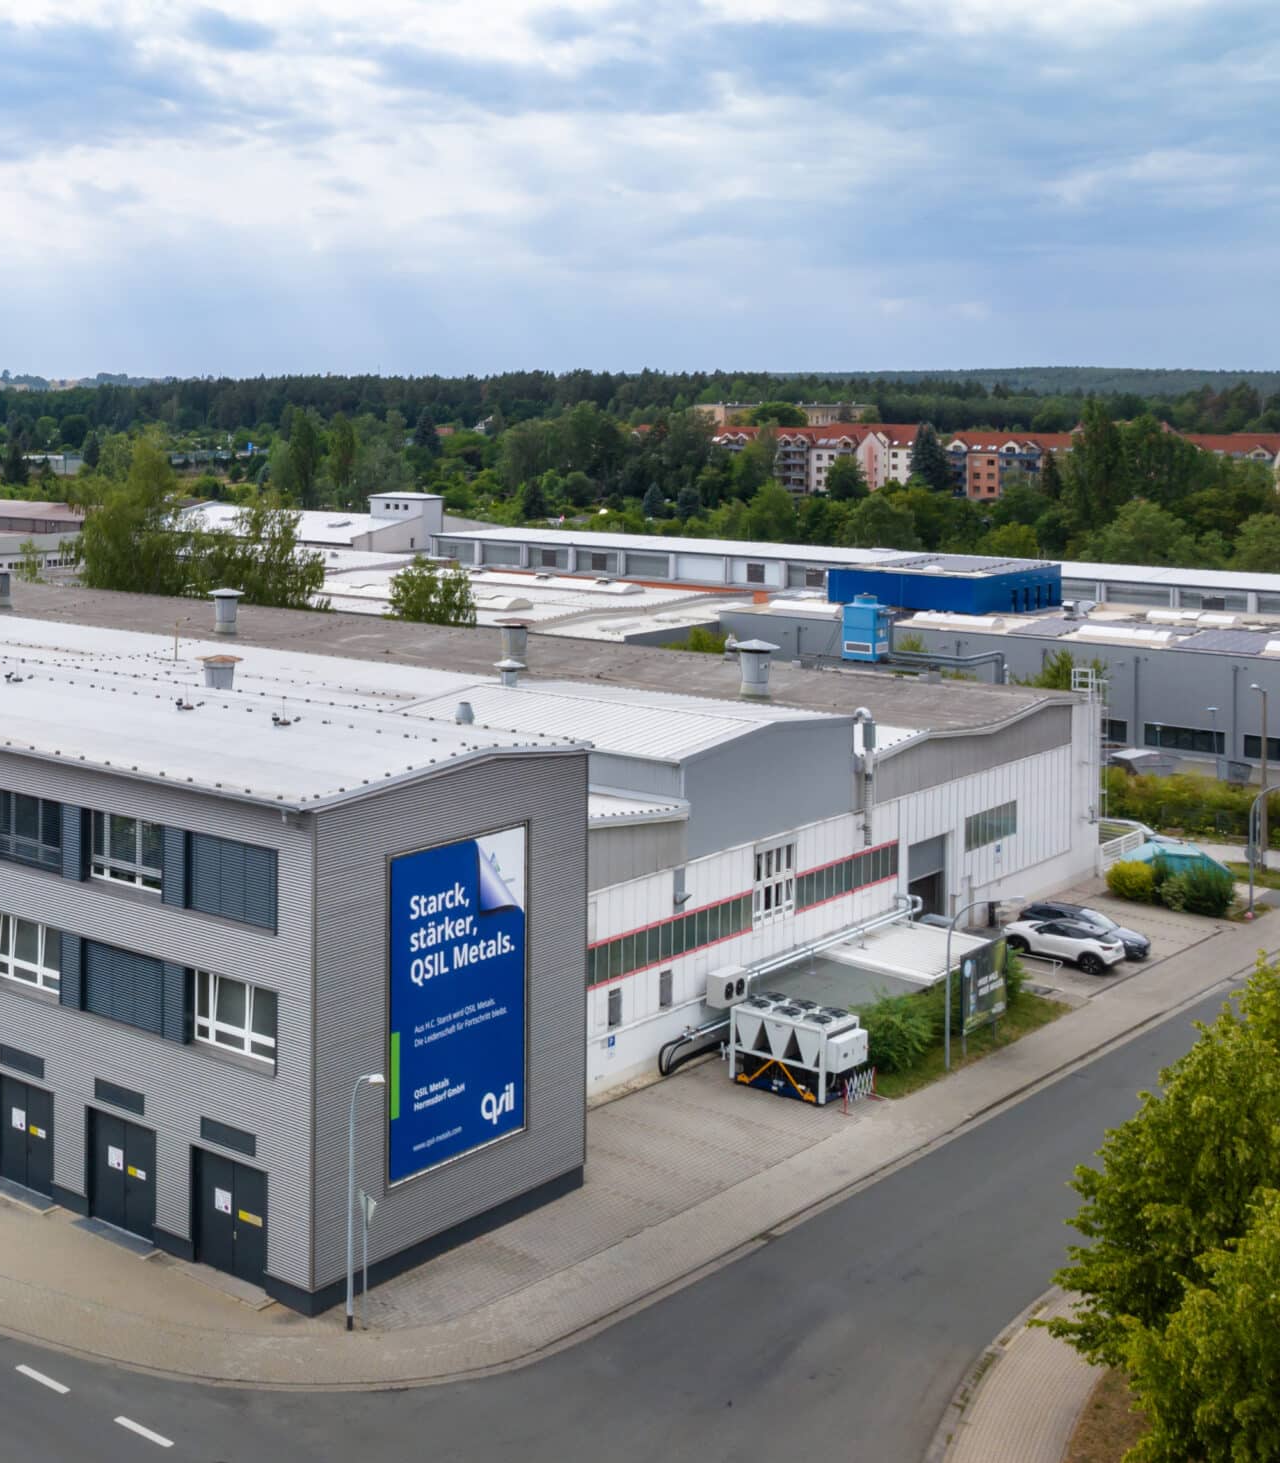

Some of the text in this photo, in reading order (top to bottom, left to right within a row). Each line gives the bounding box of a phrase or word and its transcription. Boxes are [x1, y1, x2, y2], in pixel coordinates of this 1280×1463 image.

[410, 882, 469, 920] Starck,
[410, 915, 478, 952] stärker,
[410, 931, 515, 986] QSIL Metals.
[413, 1078, 450, 1100] QSIL Metals
